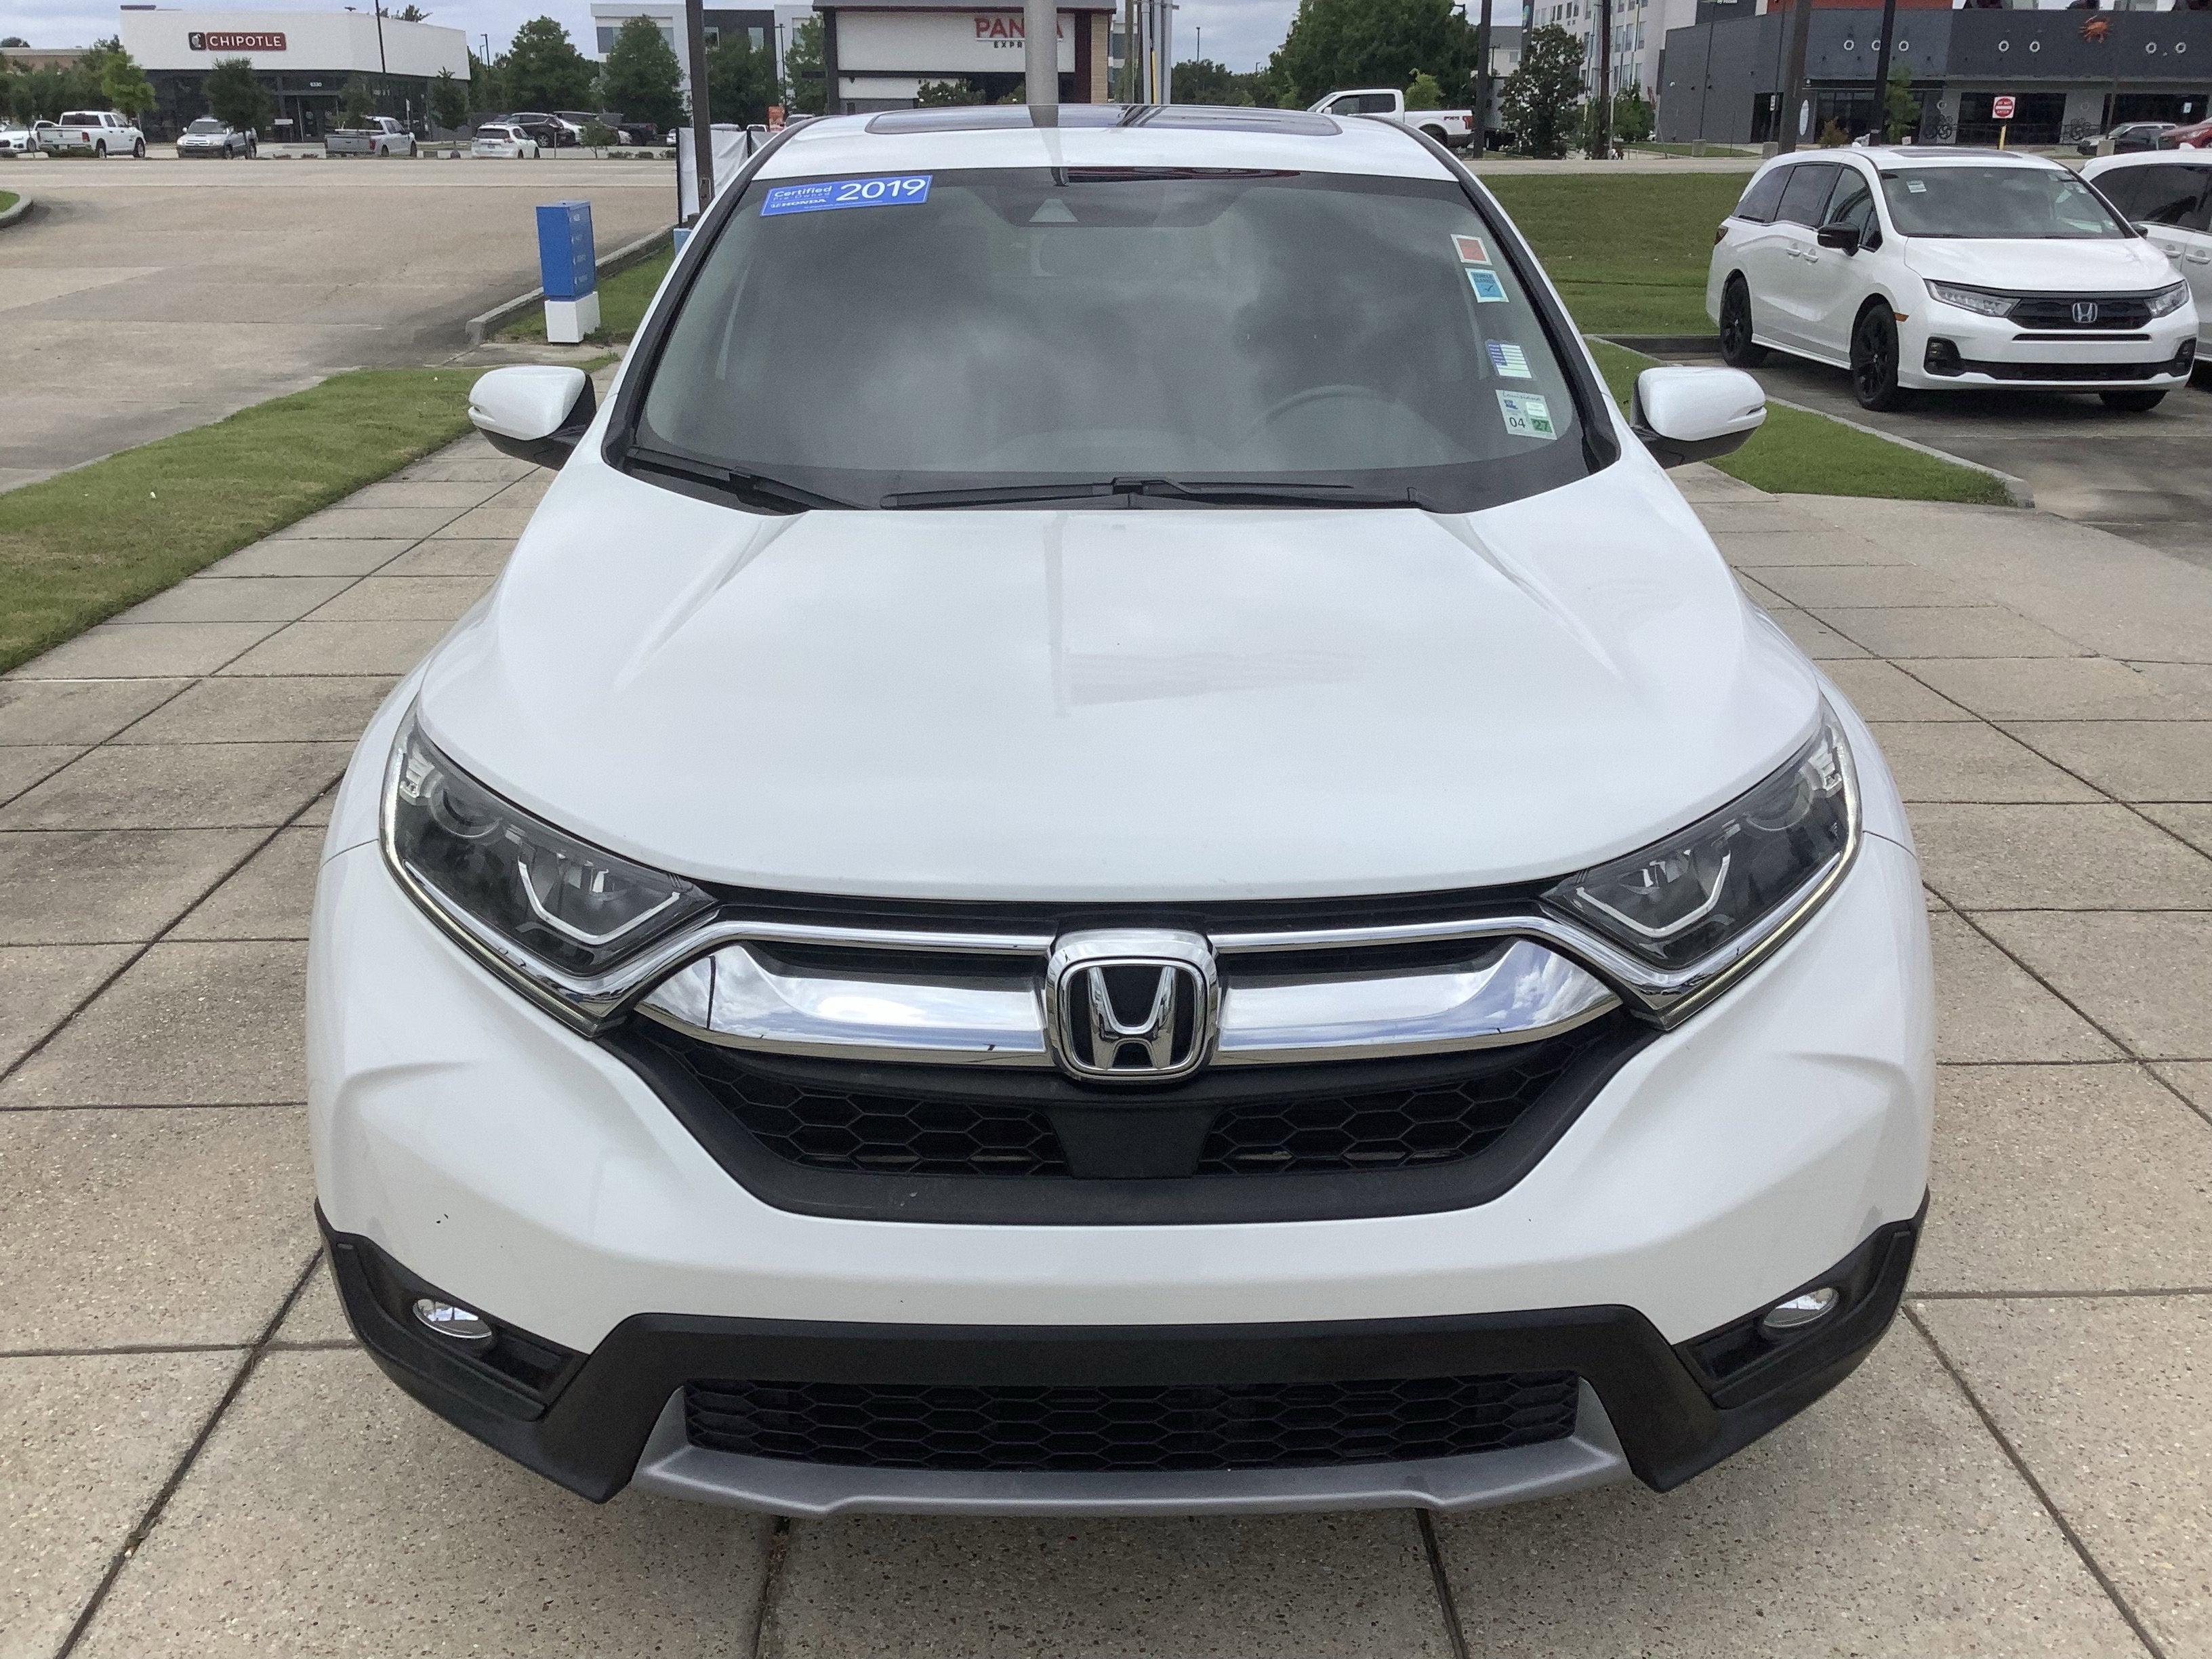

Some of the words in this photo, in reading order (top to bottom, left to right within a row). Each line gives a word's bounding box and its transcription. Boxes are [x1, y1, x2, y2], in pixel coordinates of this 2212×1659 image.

[975, 18, 1064, 39] PAN
[209, 36, 282, 47] CHIPOTLE
[774, 185, 832, 198] Certified
[836, 178, 926, 202] 2019
[781, 199, 827, 207] HONDA
[1509, 417, 1525, 428] 04
